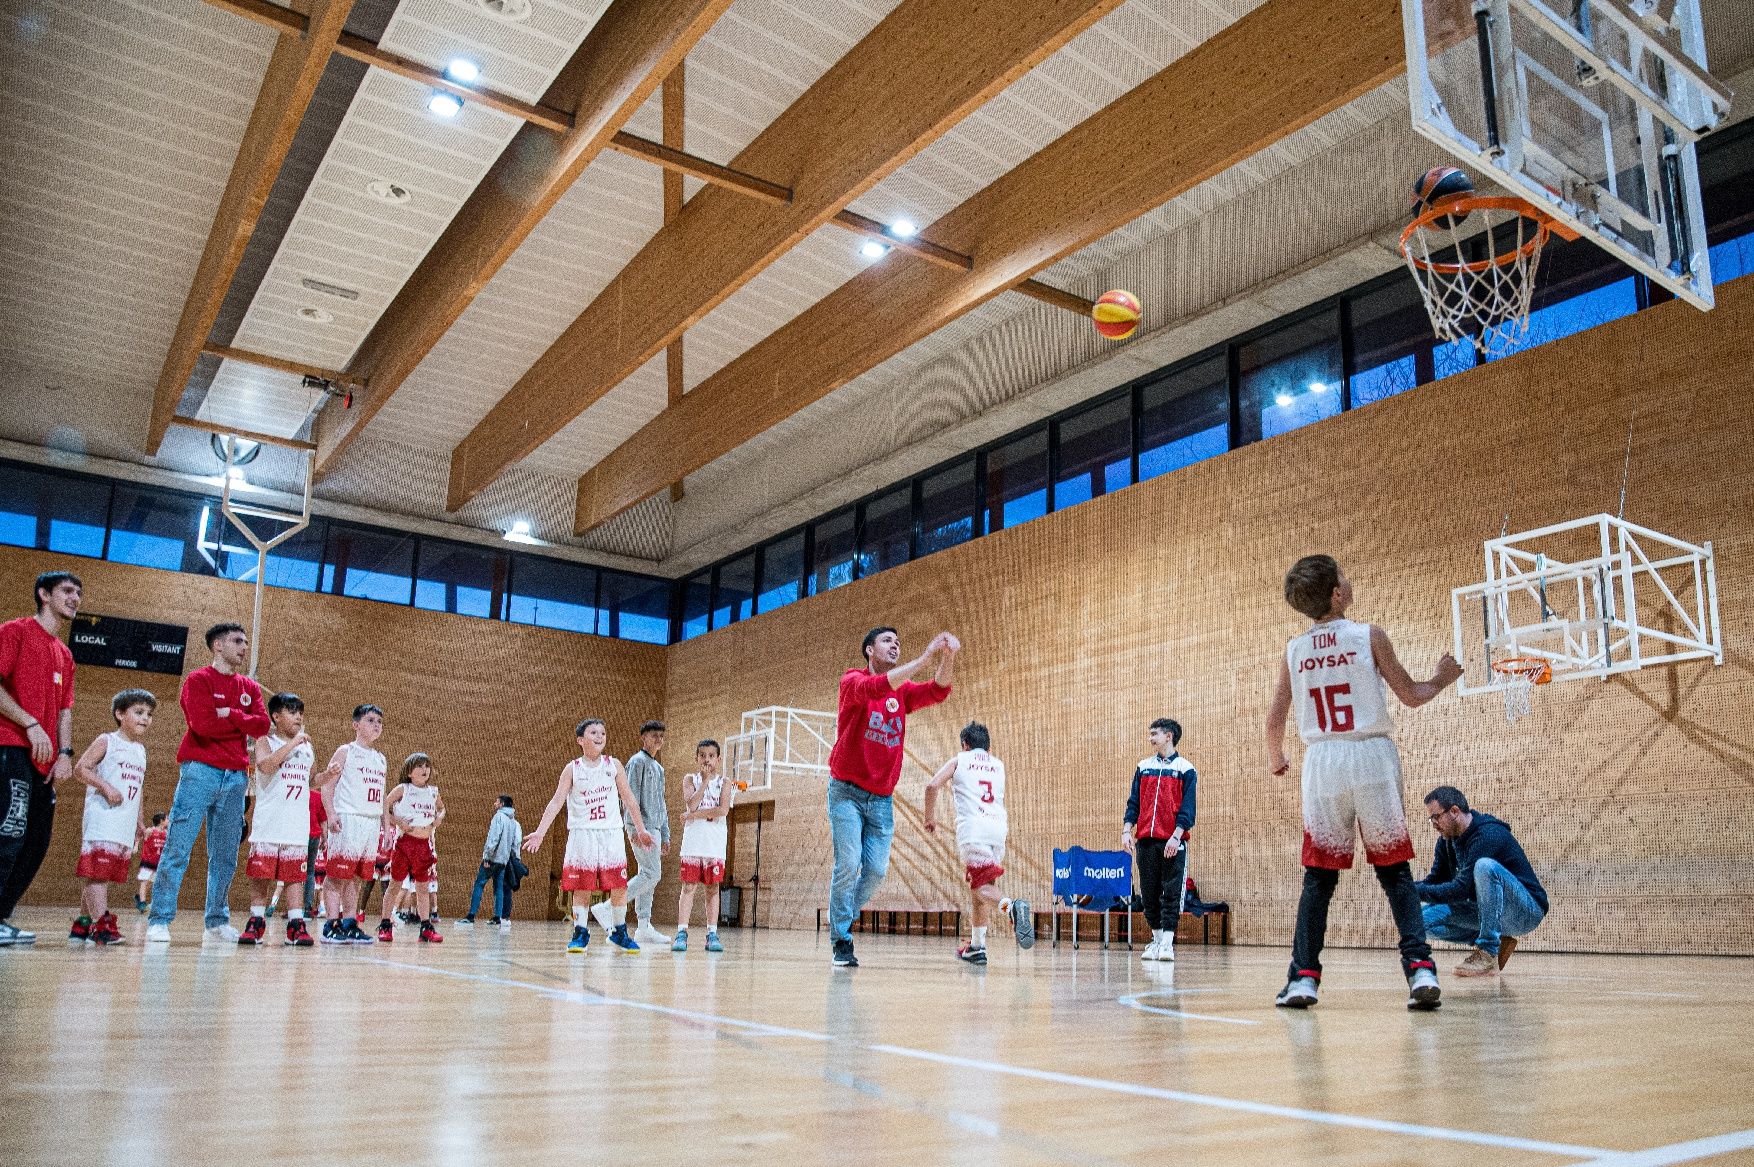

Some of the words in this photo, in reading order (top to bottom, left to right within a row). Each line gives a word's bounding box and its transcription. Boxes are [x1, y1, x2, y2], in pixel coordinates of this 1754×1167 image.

[75, 634, 107, 646] LOCAL
[1311, 632, 1337, 650] TOM
[151, 643, 181, 655] VISITANT
[1298, 651, 1357, 673] JOYSAT
[1308, 683, 1355, 733] 16
[967, 763, 997, 774] JOYSA
[128, 785, 138, 801] 17
[286, 785, 302, 800] 77
[368, 788, 381, 803] 00
[978, 780, 995, 804] 3
[589, 805, 606, 820] 55
[1083, 866, 1124, 880] molten
